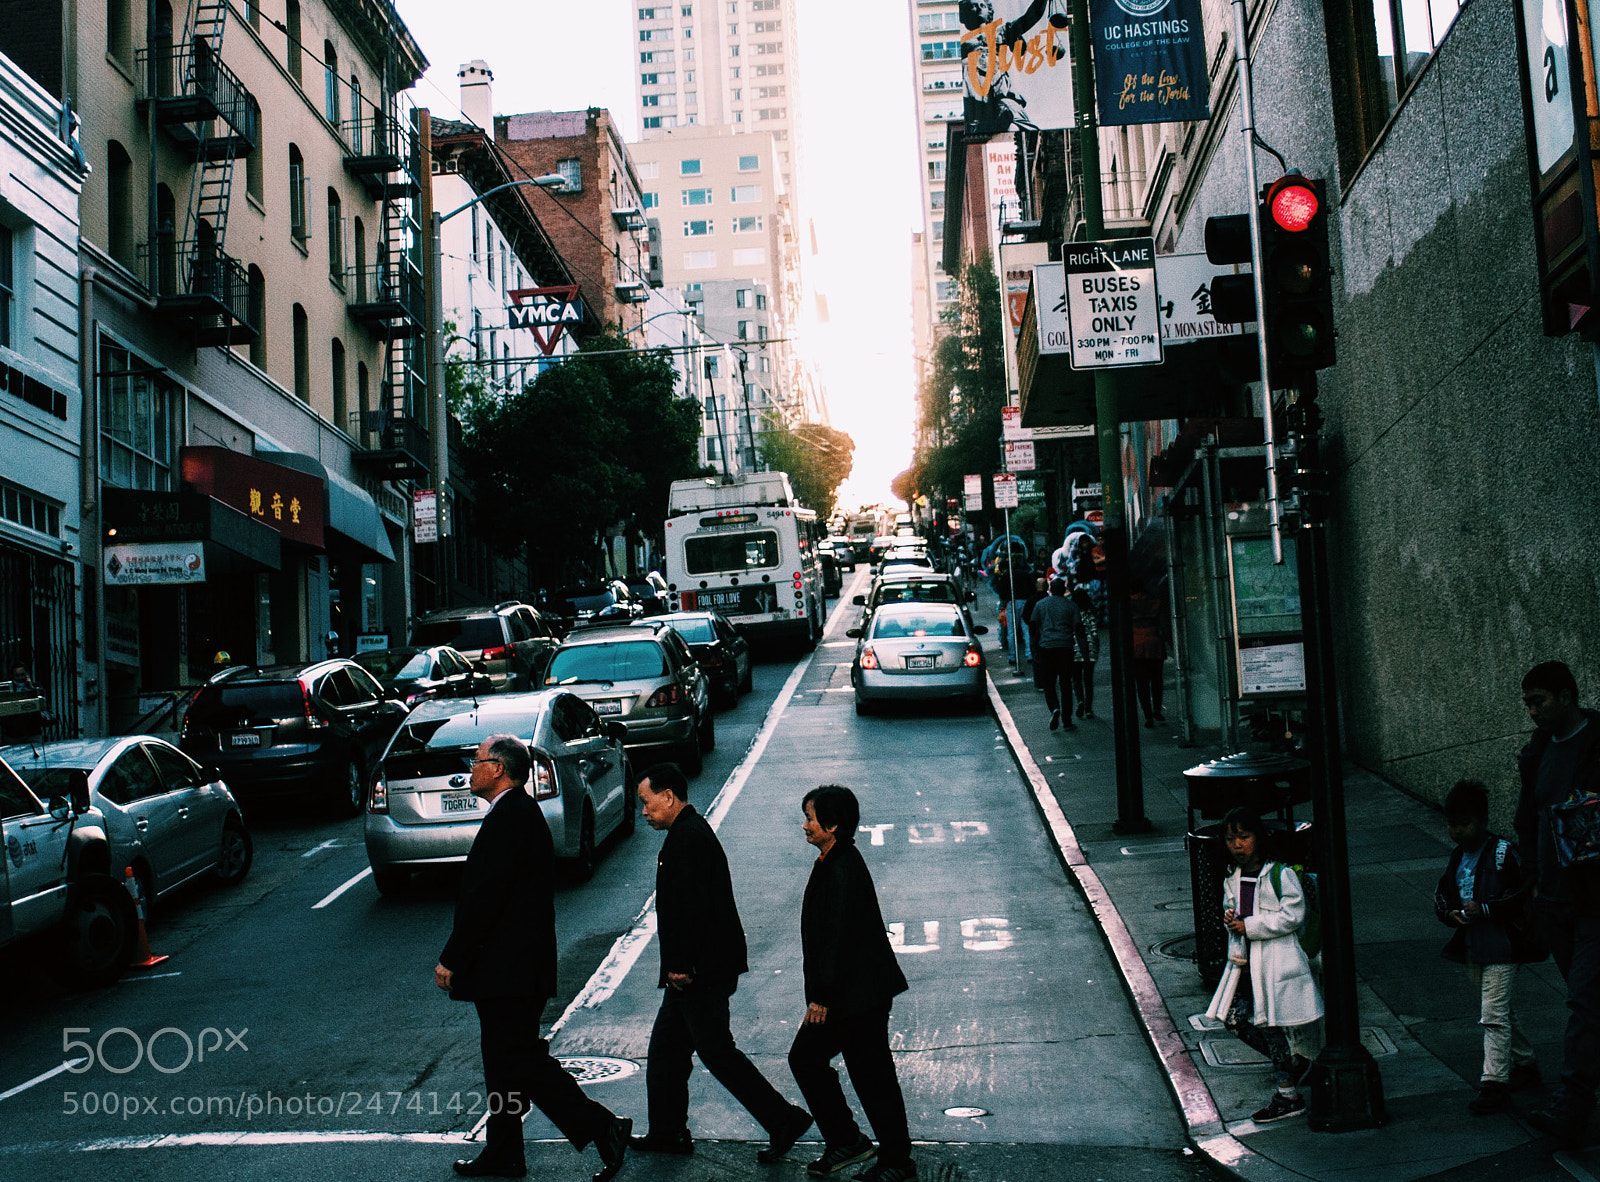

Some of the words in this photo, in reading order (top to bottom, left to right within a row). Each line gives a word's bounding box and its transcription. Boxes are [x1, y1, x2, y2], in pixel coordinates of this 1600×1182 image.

[1104, 26, 1121, 40] UC
[1124, 19, 1189, 38] HASTINGS
[1105, 41, 1140, 50] COLLEGE
[961, 18, 1068, 97] Just
[1141, 73, 1154, 85] the
[1113, 89, 1135, 110] for
[1140, 90, 1154, 102] the
[1069, 251, 1108, 266] RIGHT
[1113, 248, 1149, 263] LANE
[1082, 276, 1141, 294] BUSES
[511, 302, 579, 325] YMCA
[1089, 296, 1137, 314] TAXIS
[1092, 315, 1136, 333] ONLY
[1047, 331, 1069, 347] GOL
[1175, 320, 1235, 338] MONASTERY
[1077, 338, 1096, 348] 3:30
[1097, 337, 1110, 347] PM
[1120, 336, 1140, 346] 7:00
[1141, 334, 1155, 345] PM
[1095, 348, 1114, 360] MON
[1125, 348, 1139, 358] FRI
[249, 487, 302, 524] 觀音堂
[766, 510, 784, 519] 5494
[698, 594, 712, 606] FOOL
[713, 593, 725, 604] FOR
[726, 591, 741, 603] LOVE
[443, 798, 477, 811] 7DGR742
[858, 821, 991, 846] TOP
[887, 918, 1014, 954] US
